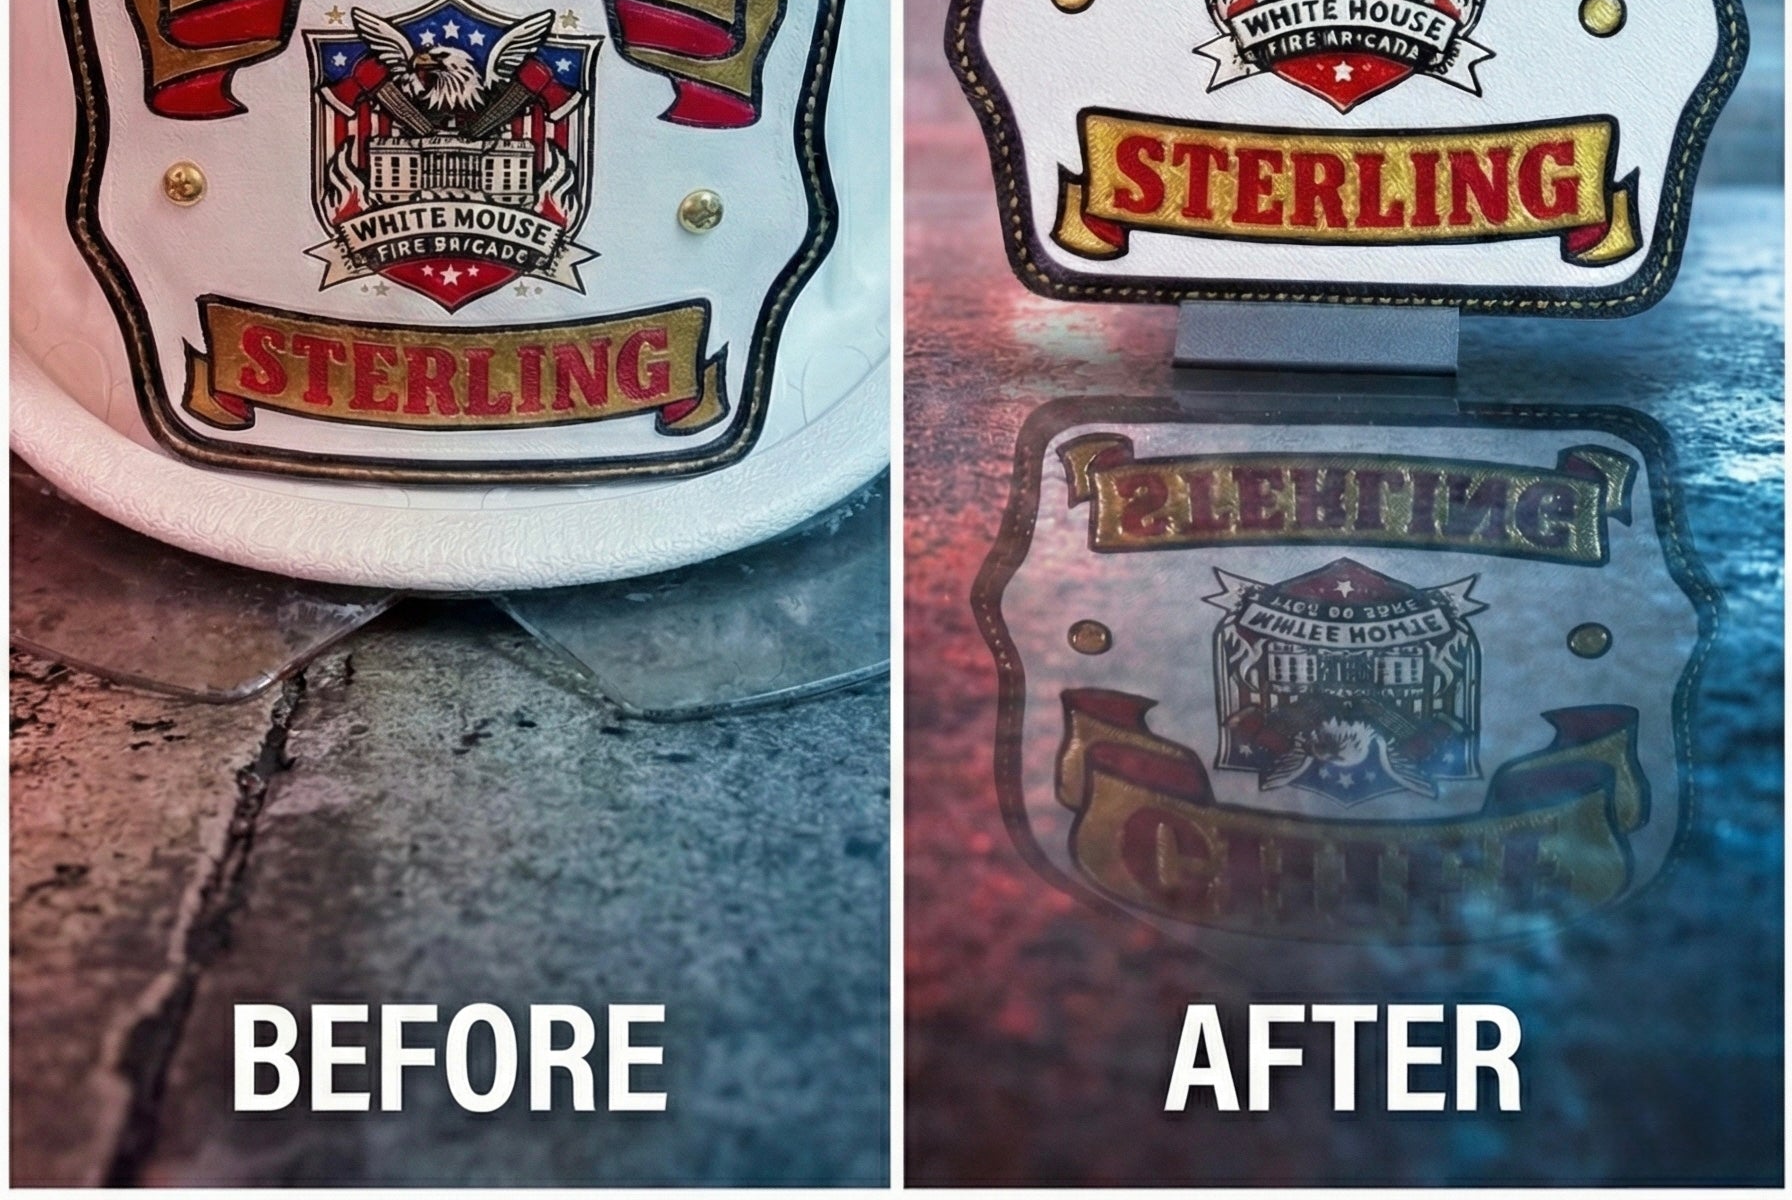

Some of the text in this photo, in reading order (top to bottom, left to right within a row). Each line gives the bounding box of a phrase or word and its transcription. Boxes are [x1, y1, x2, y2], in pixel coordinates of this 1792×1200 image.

[1268, 30, 1317, 57] FIRE
[1112, 134, 1581, 229] STERLING
[351, 206, 553, 247] WHITE MOUSE
[377, 238, 426, 262] FIRE
[239, 324, 671, 417] STERLING
